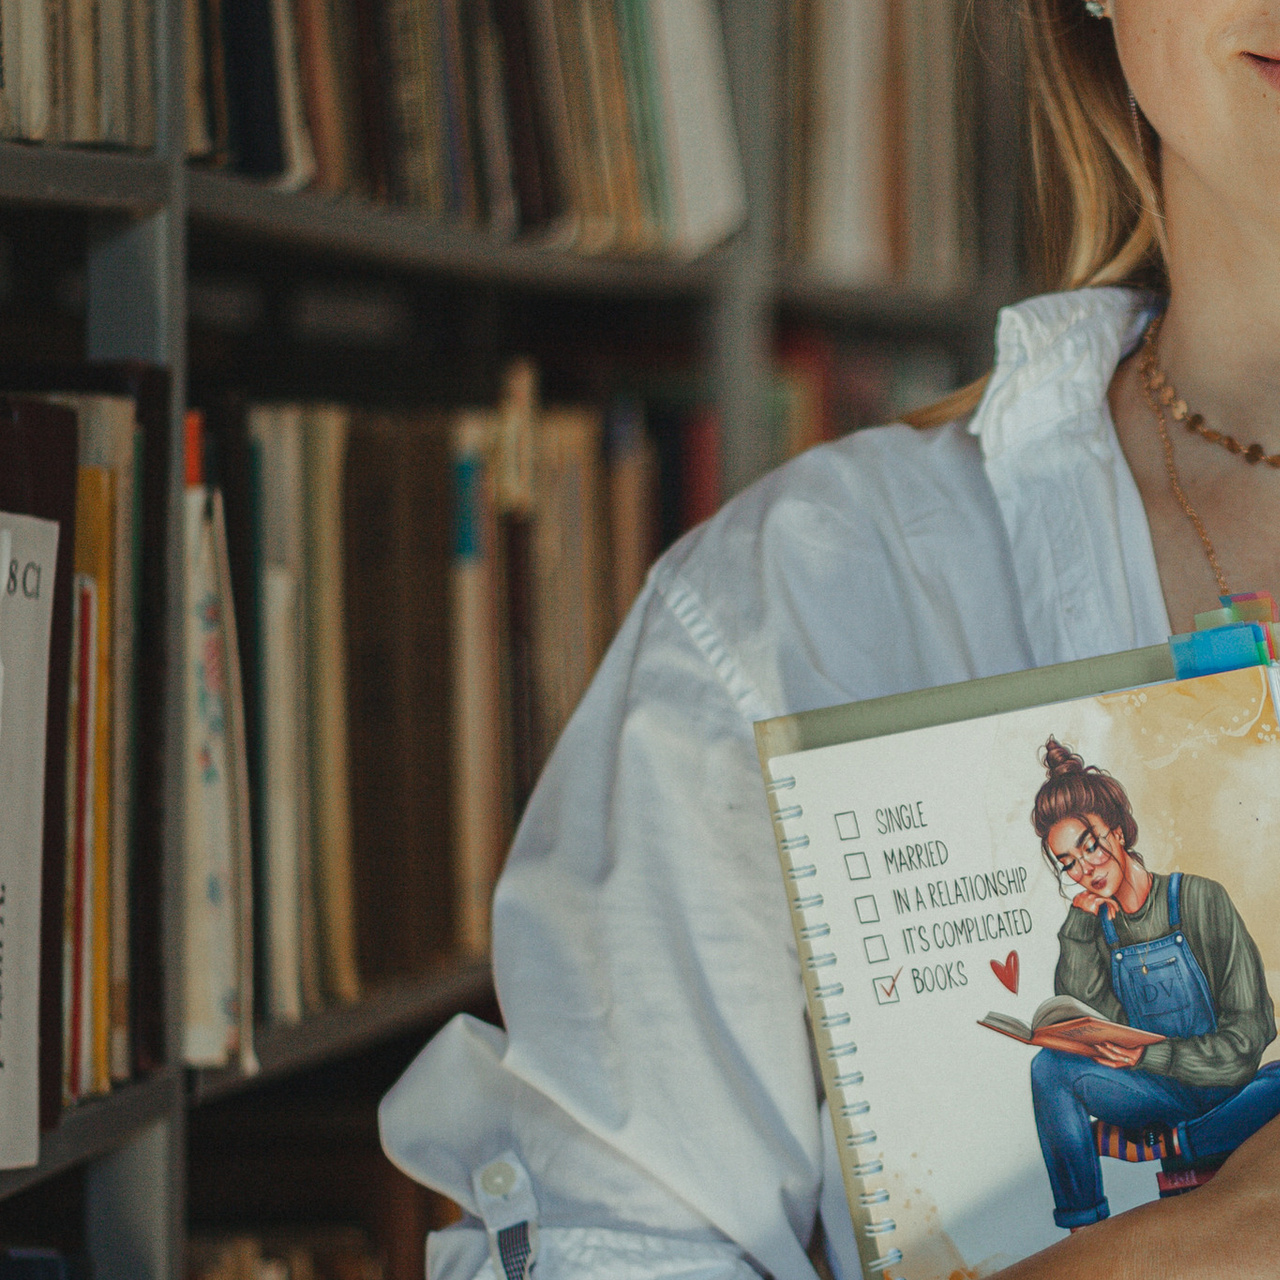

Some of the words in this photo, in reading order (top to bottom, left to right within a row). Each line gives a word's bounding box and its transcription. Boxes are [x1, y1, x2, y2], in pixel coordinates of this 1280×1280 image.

[875, 801, 928, 835] SINGLE
[883, 840, 949, 875] MARRIED
[893, 888, 911, 915] IN
[916, 886, 927, 912] A
[930, 866, 1028, 908] RELATIONSHIP
[902, 925, 931, 955] IT'S
[933, 908, 1032, 949] COMPLICATED
[911, 960, 968, 994] BOOKS
[1143, 978, 1175, 1003] DV
